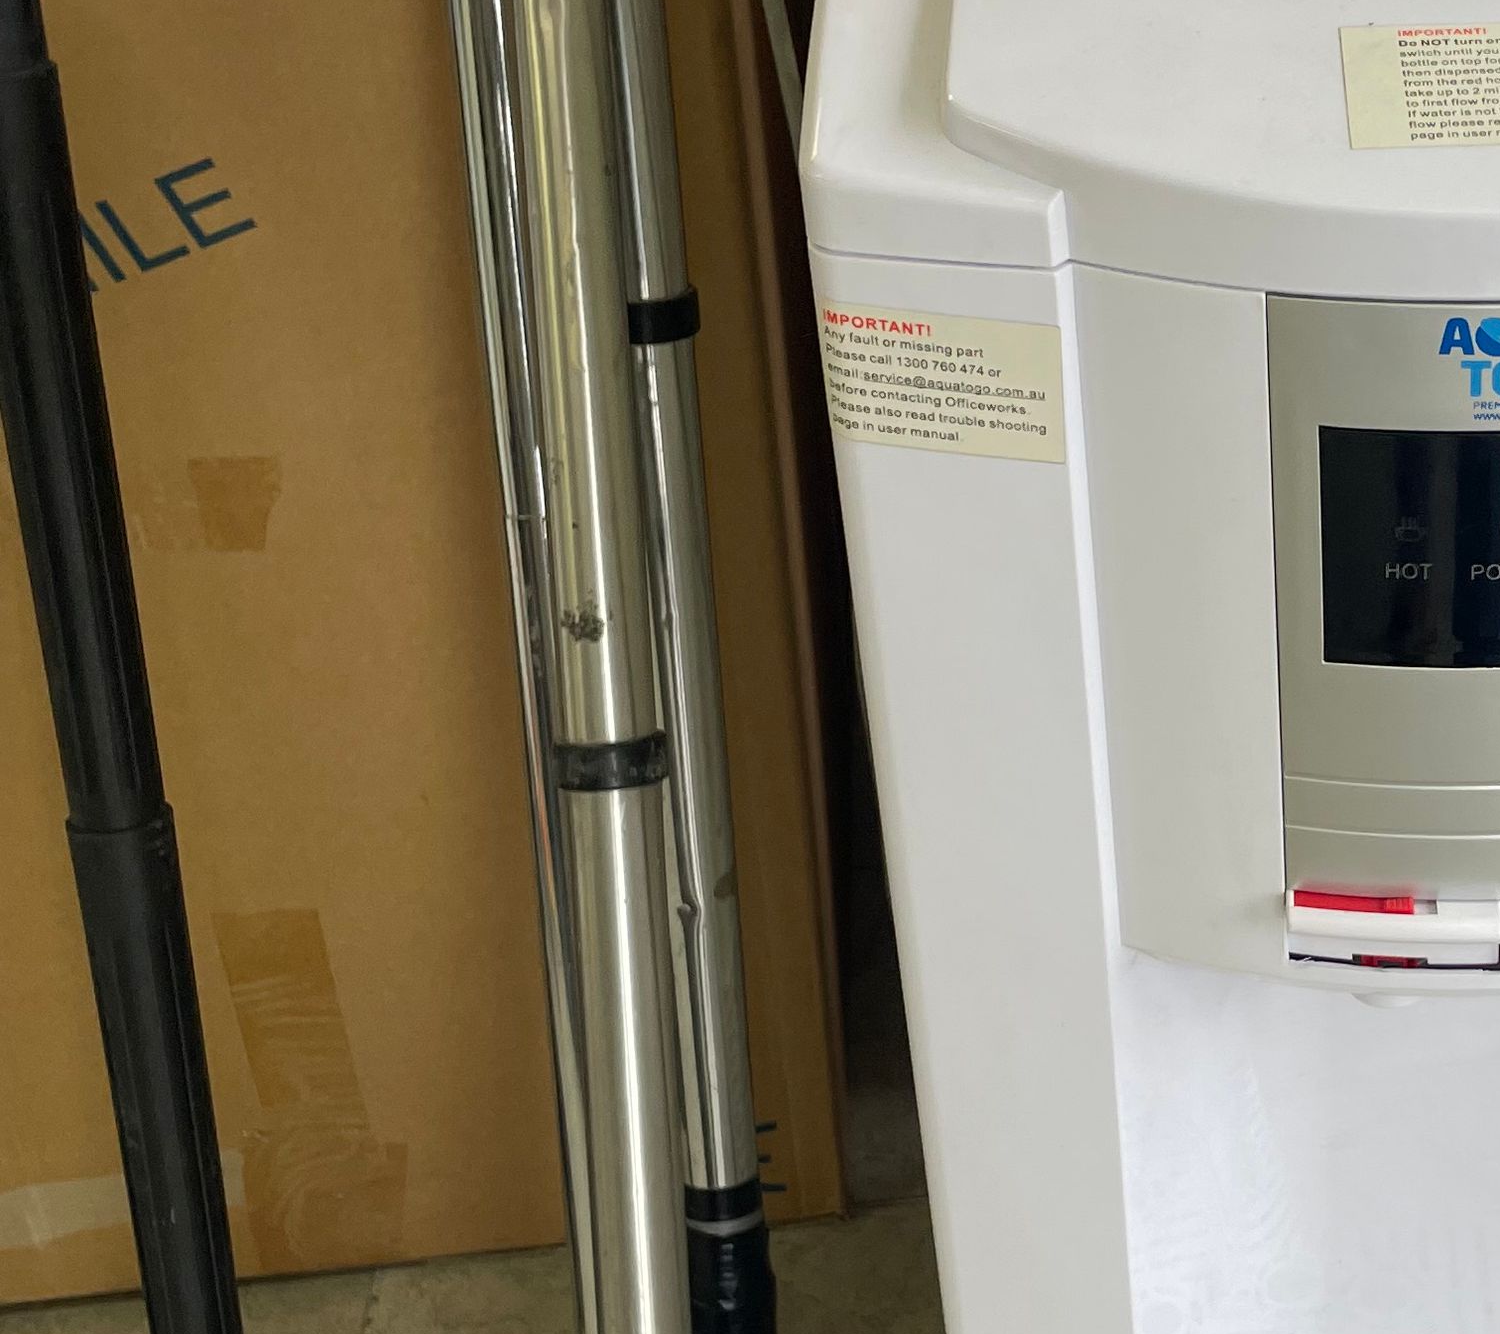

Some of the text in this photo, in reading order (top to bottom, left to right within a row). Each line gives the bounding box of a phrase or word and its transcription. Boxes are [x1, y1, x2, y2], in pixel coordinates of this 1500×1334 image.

[1398, 28, 1486, 36] IMPORTANT!
[1461, 58, 1481, 66] top
[1437, 89, 1452, 97] up
[1451, 98, 1478, 106] flow
[1440, 119, 1484, 128] please
[1411, 132, 1443, 141] page
[1463, 130, 1492, 138] user
[823, 309, 931, 337] IMPORTANT!
[824, 326, 983, 358] Any fault or missing part
[826, 344, 1001, 377] Please call 1300 760 474 or
[830, 377, 867, 396] before
[871, 390, 941, 407] contacting
[831, 394, 1046, 435] Please also read trouble shooting
[863, 420, 874, 431] in
[878, 425, 907, 435] user
[1385, 563, 1432, 580] HOT
